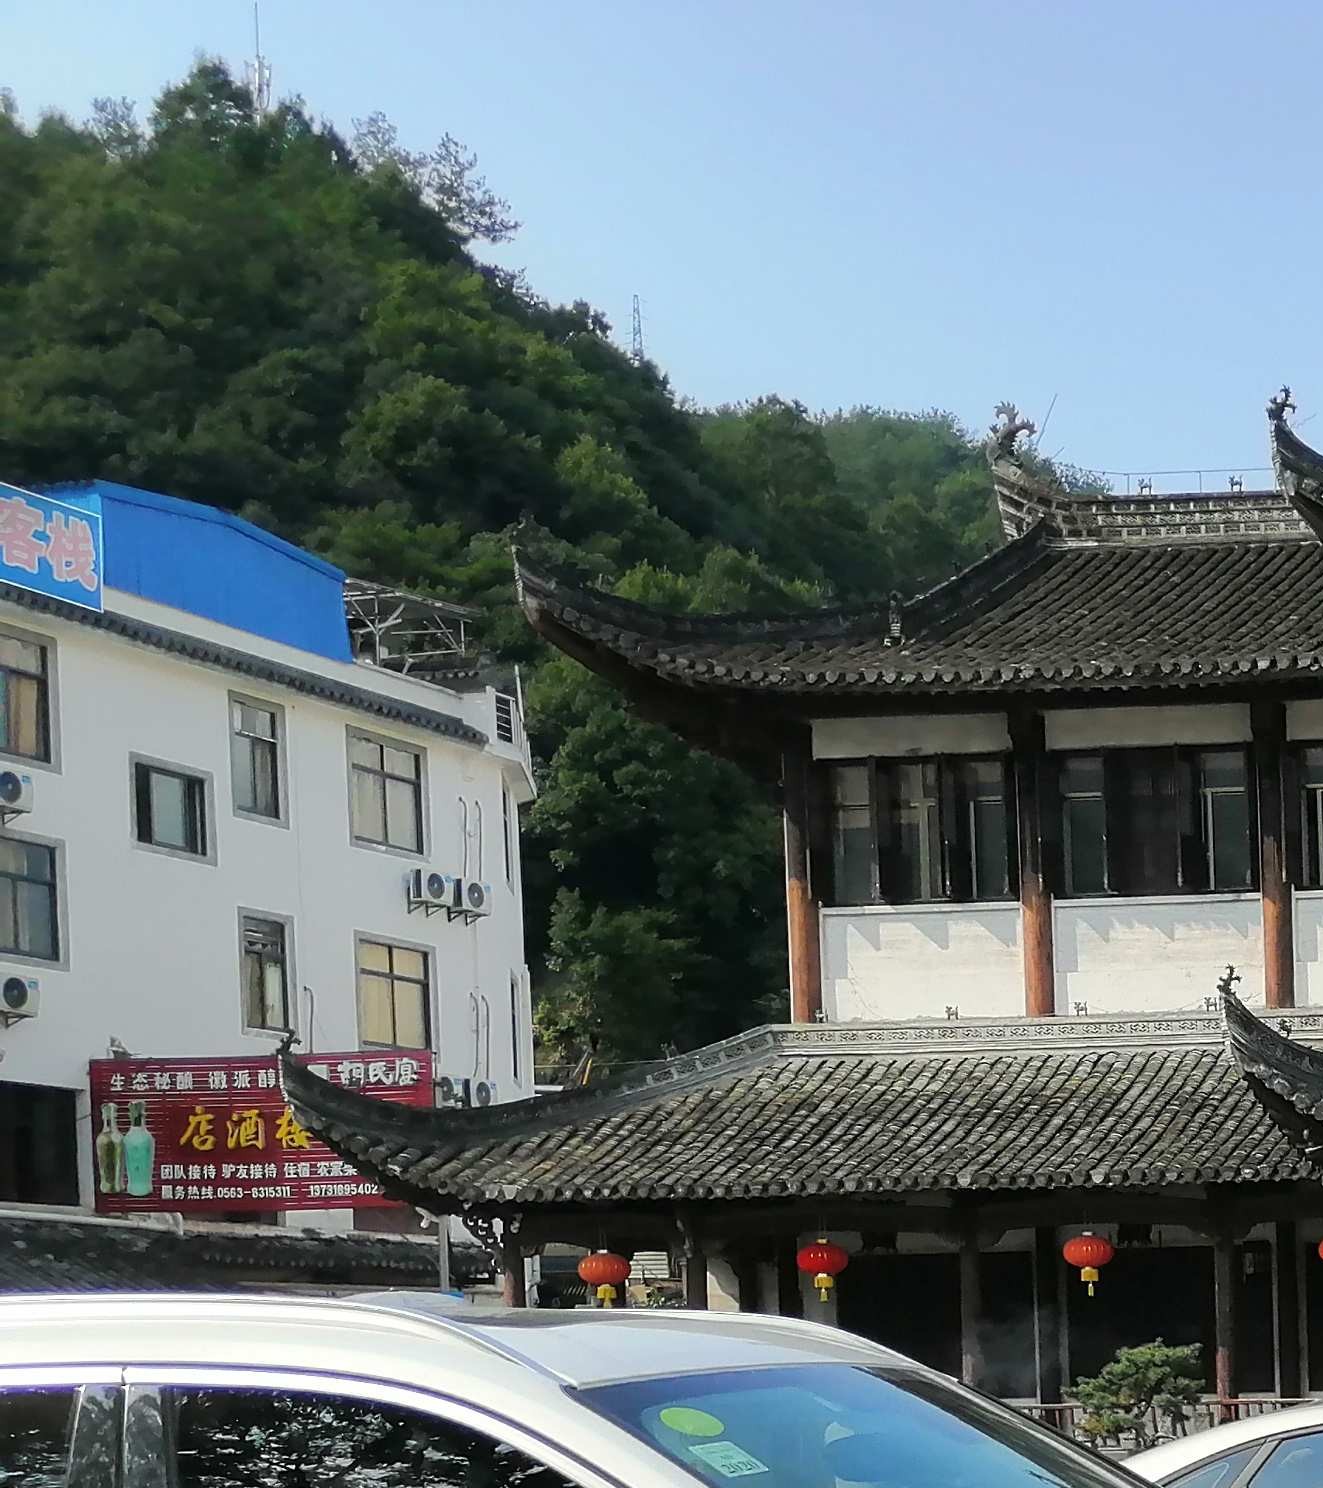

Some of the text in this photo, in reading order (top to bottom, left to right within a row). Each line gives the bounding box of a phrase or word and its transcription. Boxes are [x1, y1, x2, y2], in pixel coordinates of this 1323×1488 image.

[0, 496, 98, 592] 客栈
[208, 1068, 277, 1089] 徽派醇
[160, 1164, 217, 1180] 团队接待
